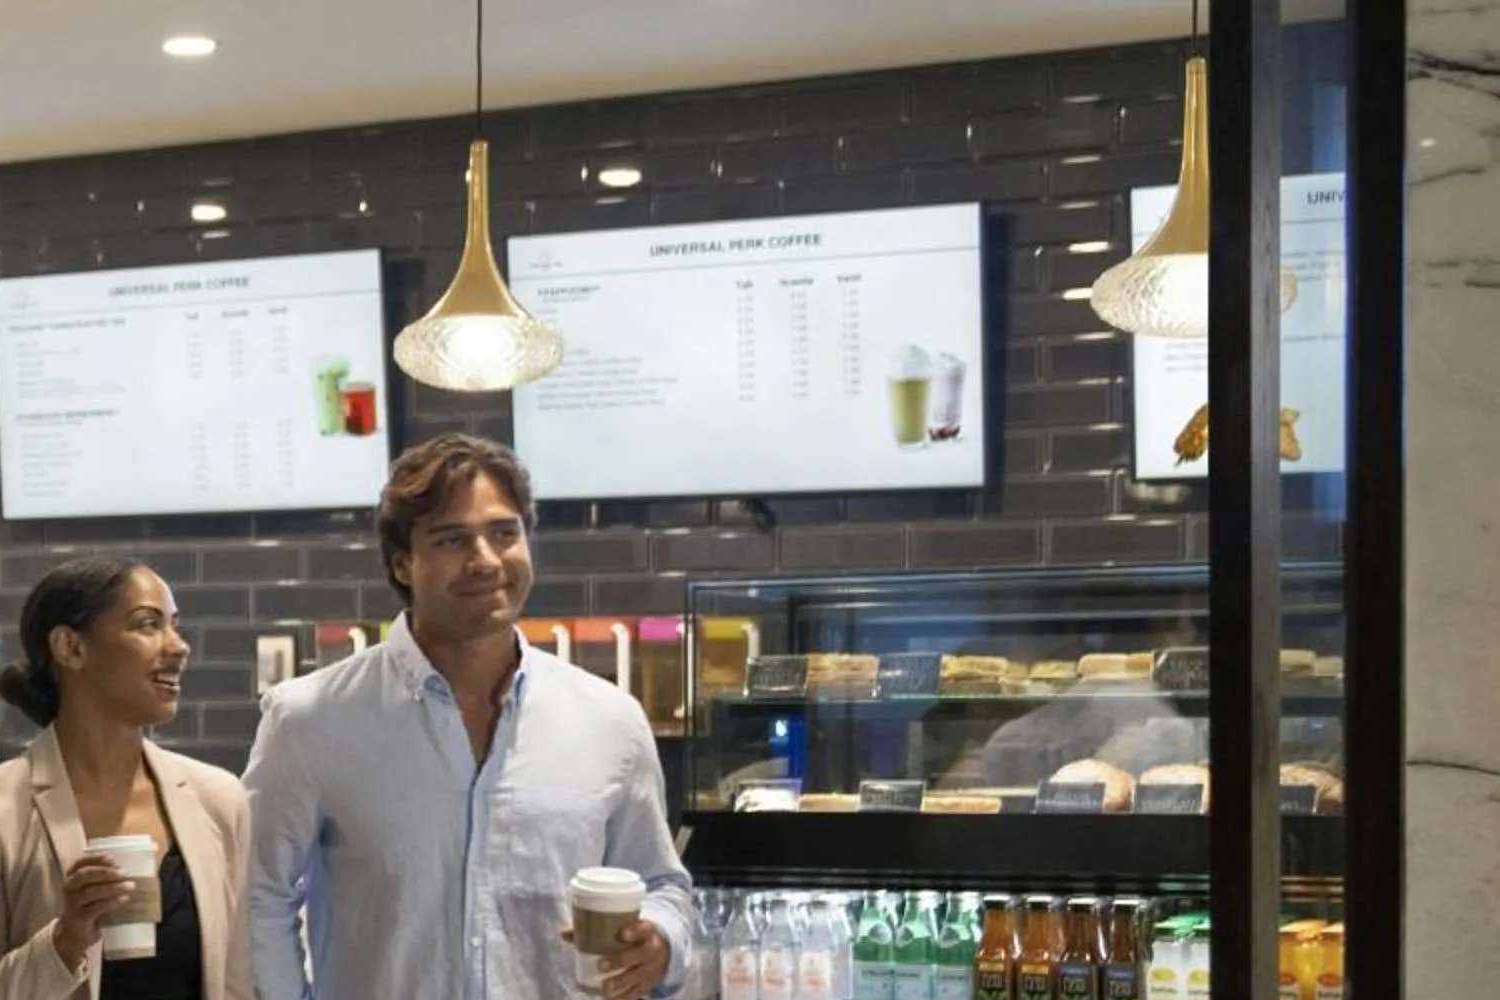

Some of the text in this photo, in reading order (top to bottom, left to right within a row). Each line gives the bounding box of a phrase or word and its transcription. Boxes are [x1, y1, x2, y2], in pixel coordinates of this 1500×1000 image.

[649, 233, 822, 257] UNIVERSAL PERK COFFEE
[108, 284, 169, 297] UNIVERSAL
[206, 276, 250, 290] COFFEE
